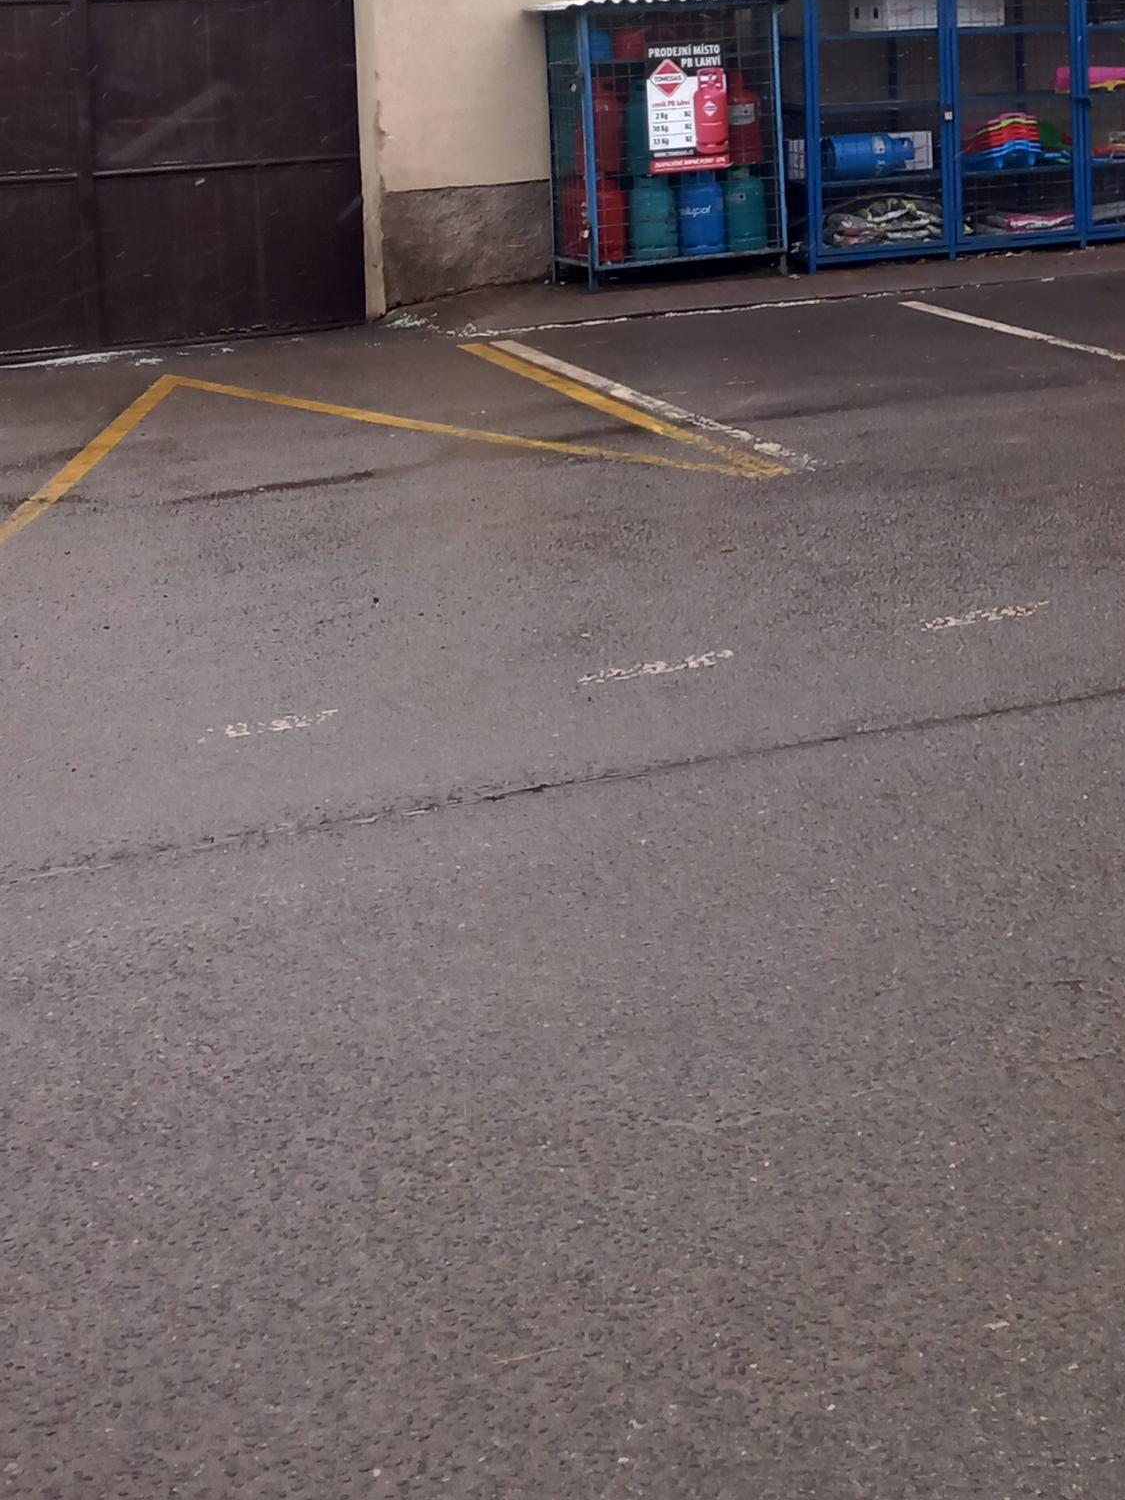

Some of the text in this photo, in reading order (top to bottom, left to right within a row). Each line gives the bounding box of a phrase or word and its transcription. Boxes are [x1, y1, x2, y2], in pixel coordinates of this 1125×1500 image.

[648, 43, 720, 58] PRODEJNÍ MÍSTO
[681, 55, 722, 68] PB LAHVÍ
